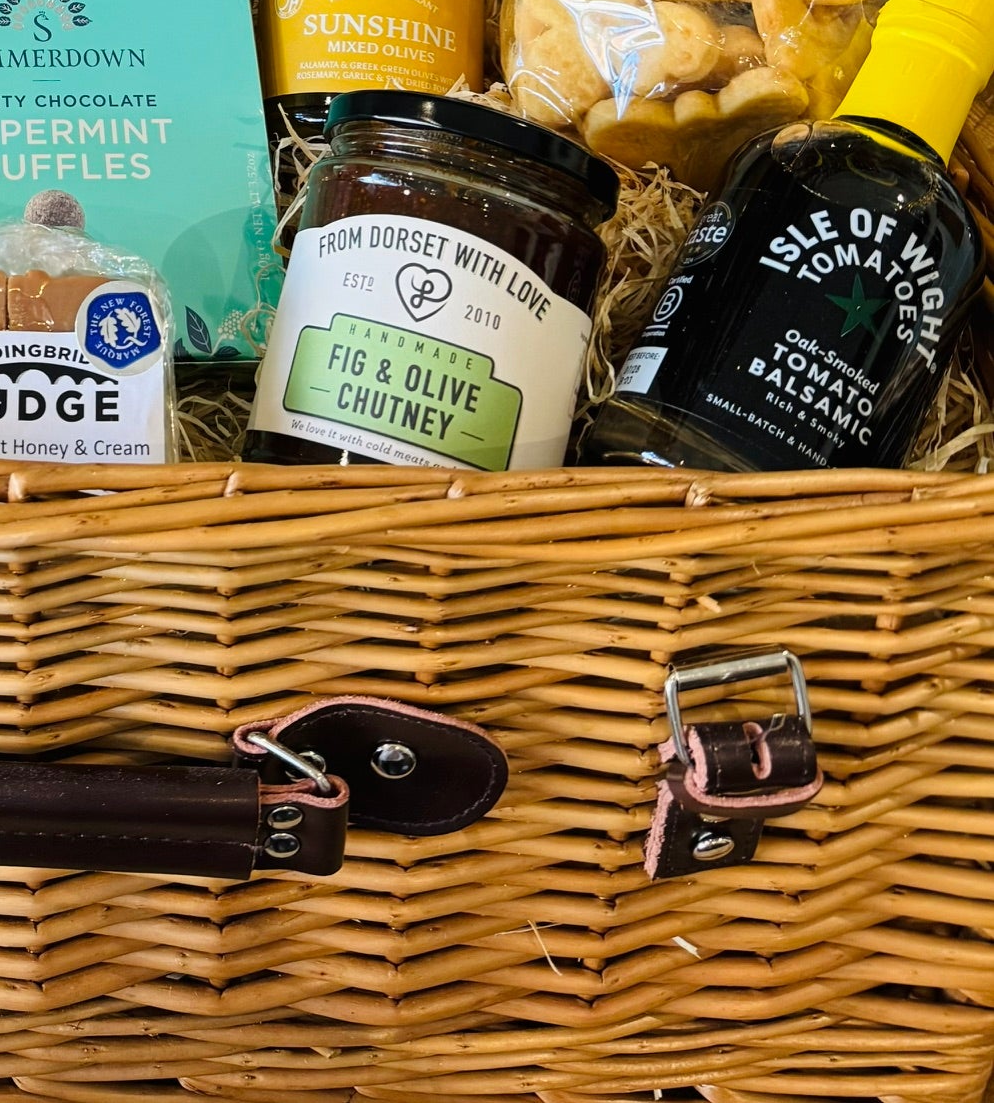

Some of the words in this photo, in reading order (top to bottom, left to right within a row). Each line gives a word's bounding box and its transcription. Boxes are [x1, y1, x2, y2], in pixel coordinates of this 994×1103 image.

[303, 13, 456, 52] SUNSHINE
[327, 41, 379, 54] MIXED
[382, 44, 435, 64] OLIVES
[34, 94, 158, 108] CHOCOLATE
[319, 226, 362, 258] FROM
[370, 226, 449, 260] DORSET
[453, 241, 506, 285] WITH
[506, 271, 551, 322] LOVE
[759, 210, 839, 274] ISLE
[849, 207, 897, 243] OF
[900, 232, 945, 370] WIGHT
[797, 243, 914, 345] TOMATOES
[464, 305, 501, 330] 2010
[328, 344, 365, 377] FIG
[376, 359, 393, 385] &
[405, 364, 482, 413] OLIVE
[773, 343, 873, 416] TOMATO
[785, 329, 881, 396] Oak-Smoked
[337, 383, 455, 440] CHUTNEY
[706, 393, 785, 440] SMALL-BATCH
[787, 432, 795, 444] &
[748, 357, 872, 447] BALSAMIC
[14, 439, 69, 459] Honey
[74, 439, 87, 455] &
[93, 439, 150, 457] Cream
[291, 419, 305, 432] We
[305, 423, 326, 437] love
[328, 427, 337, 440] it
[339, 431, 363, 447] with
[365, 438, 391, 455] cold
[394, 448, 430, 469] meats
